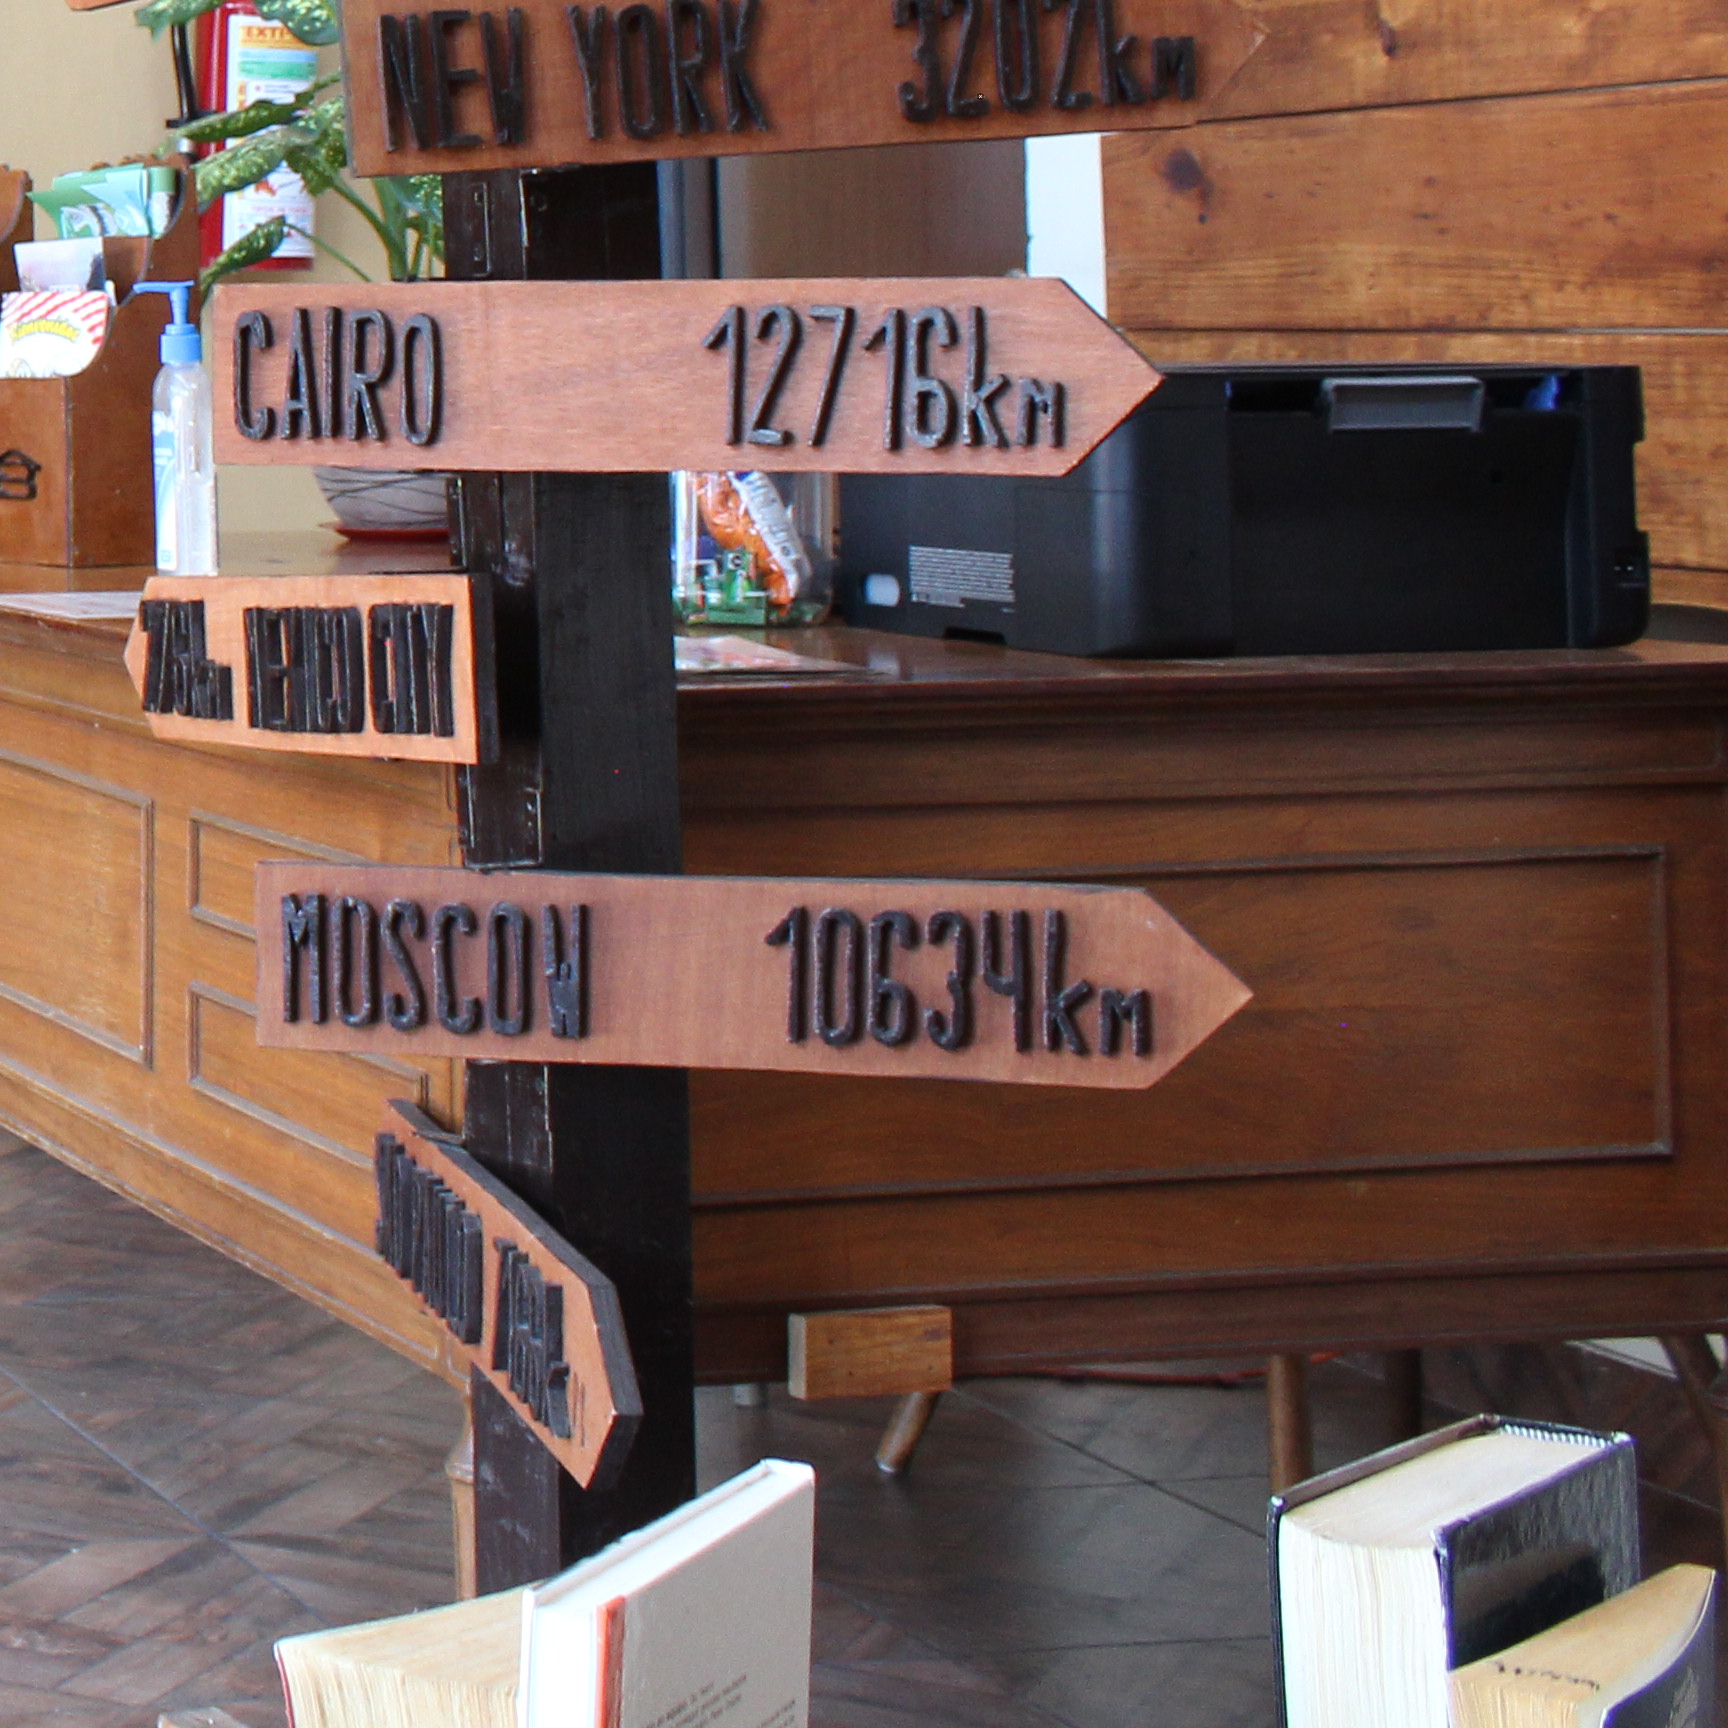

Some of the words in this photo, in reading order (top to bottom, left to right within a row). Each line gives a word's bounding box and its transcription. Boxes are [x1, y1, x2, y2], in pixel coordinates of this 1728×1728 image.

[378, 8, 528, 152] NEW
[232, 306, 442, 446] CAIRO
[701, 305, 1066, 451] 12716km
[281, 892, 588, 1040] MOSCOW
[763, 905, 1155, 1056] 10634km
